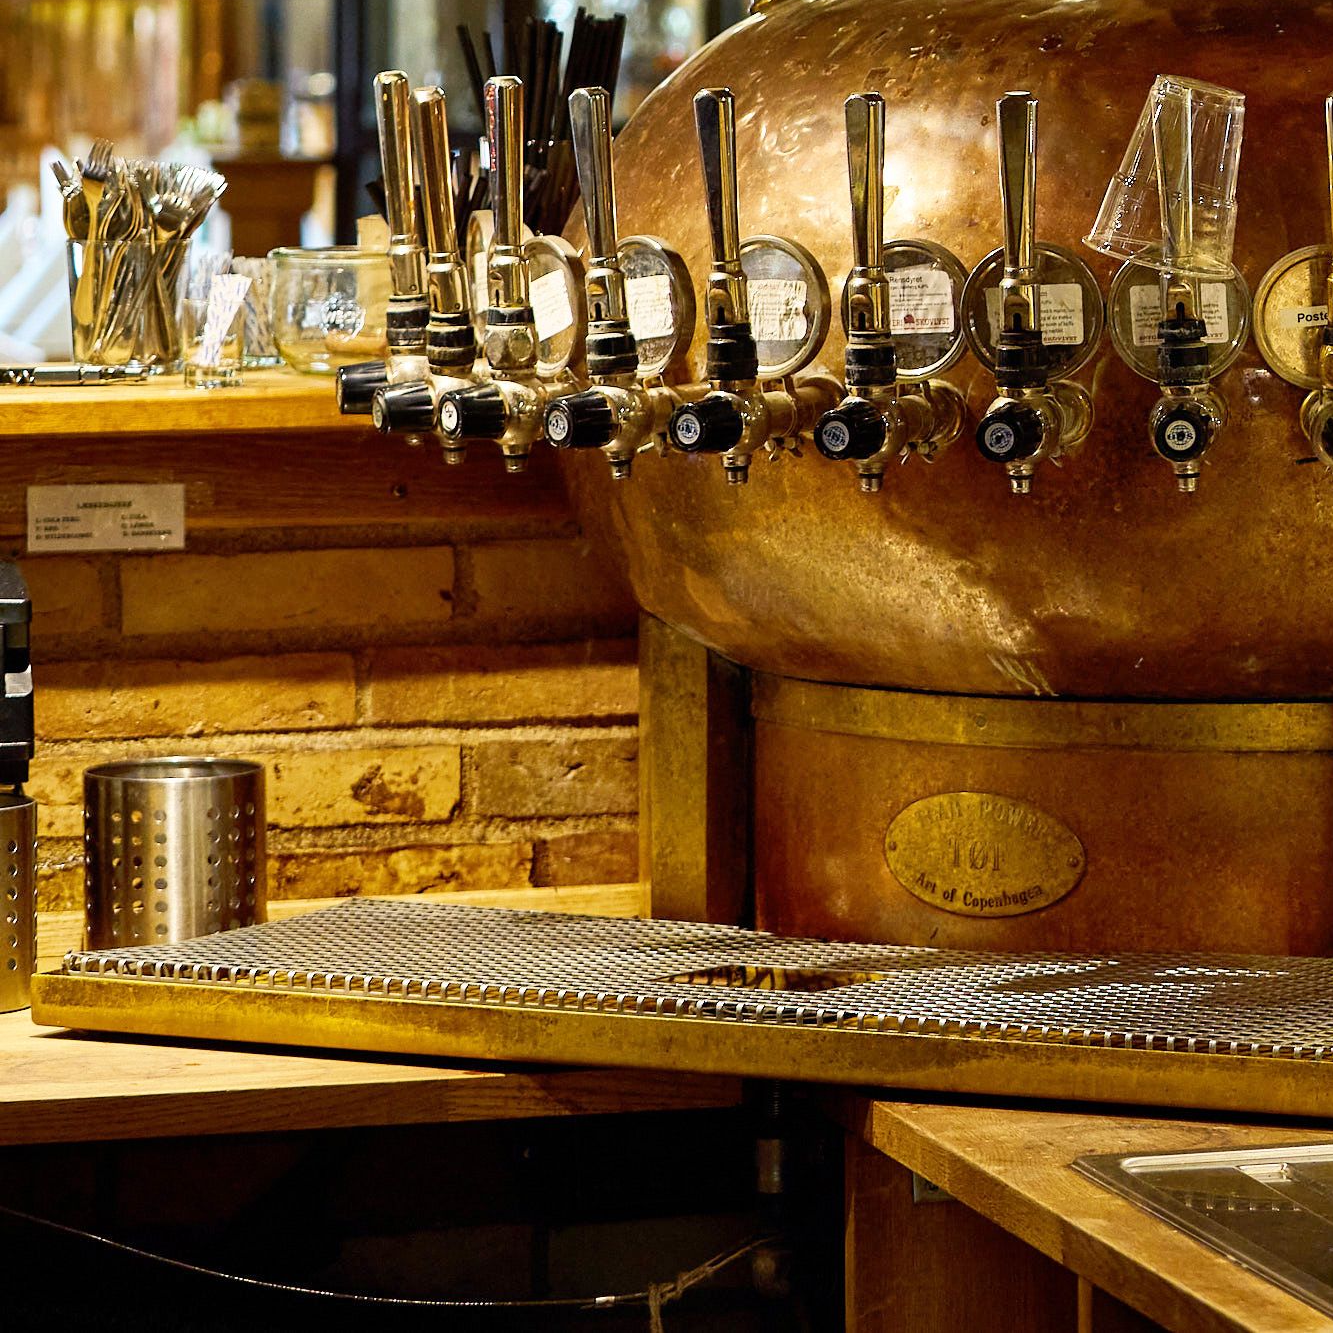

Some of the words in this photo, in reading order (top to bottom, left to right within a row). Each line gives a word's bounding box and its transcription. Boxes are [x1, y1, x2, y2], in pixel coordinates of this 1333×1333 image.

[1297, 311, 1329, 323] Poste
[916, 872, 937, 894] Art
[942, 888, 957, 902] of
[963, 884, 1045, 912] Copenhagen
